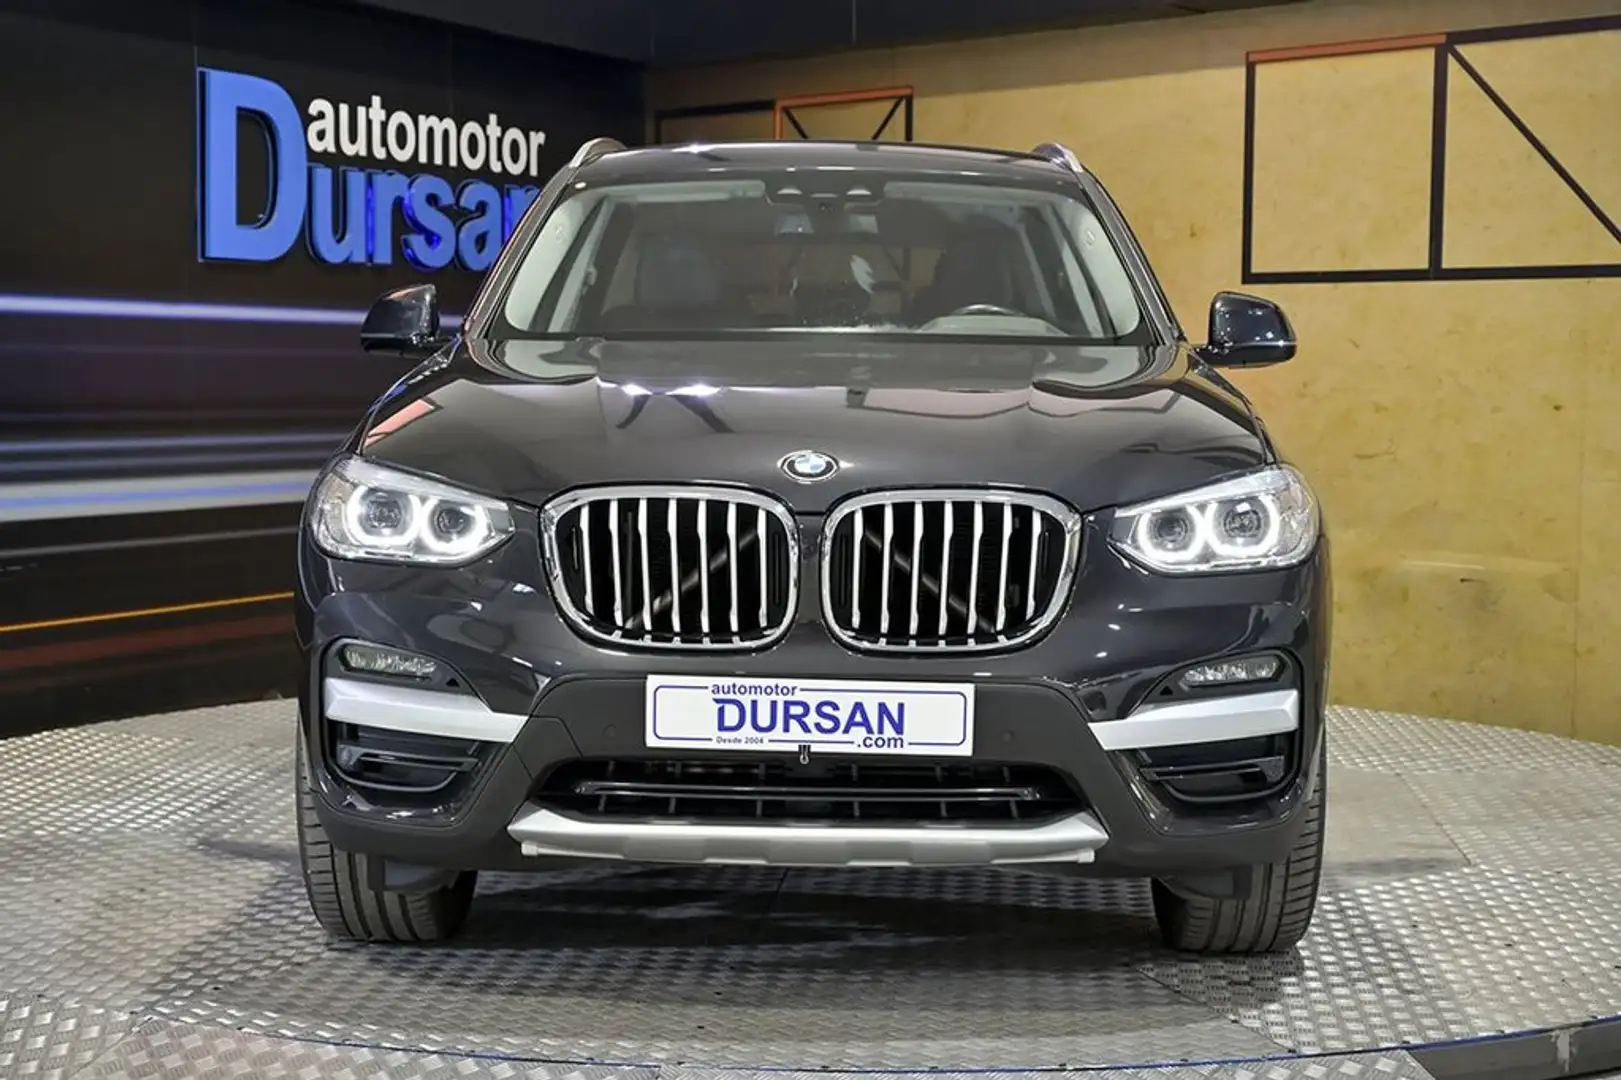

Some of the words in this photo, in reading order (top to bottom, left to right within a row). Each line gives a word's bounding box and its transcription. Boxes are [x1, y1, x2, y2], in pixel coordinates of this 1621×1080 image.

[307, 95, 545, 177] automotor
[711, 683, 797, 696] automotor
[712, 698, 904, 735] DURSAN
[716, 735, 742, 745] Desde
[856, 735, 904, 749] .com
